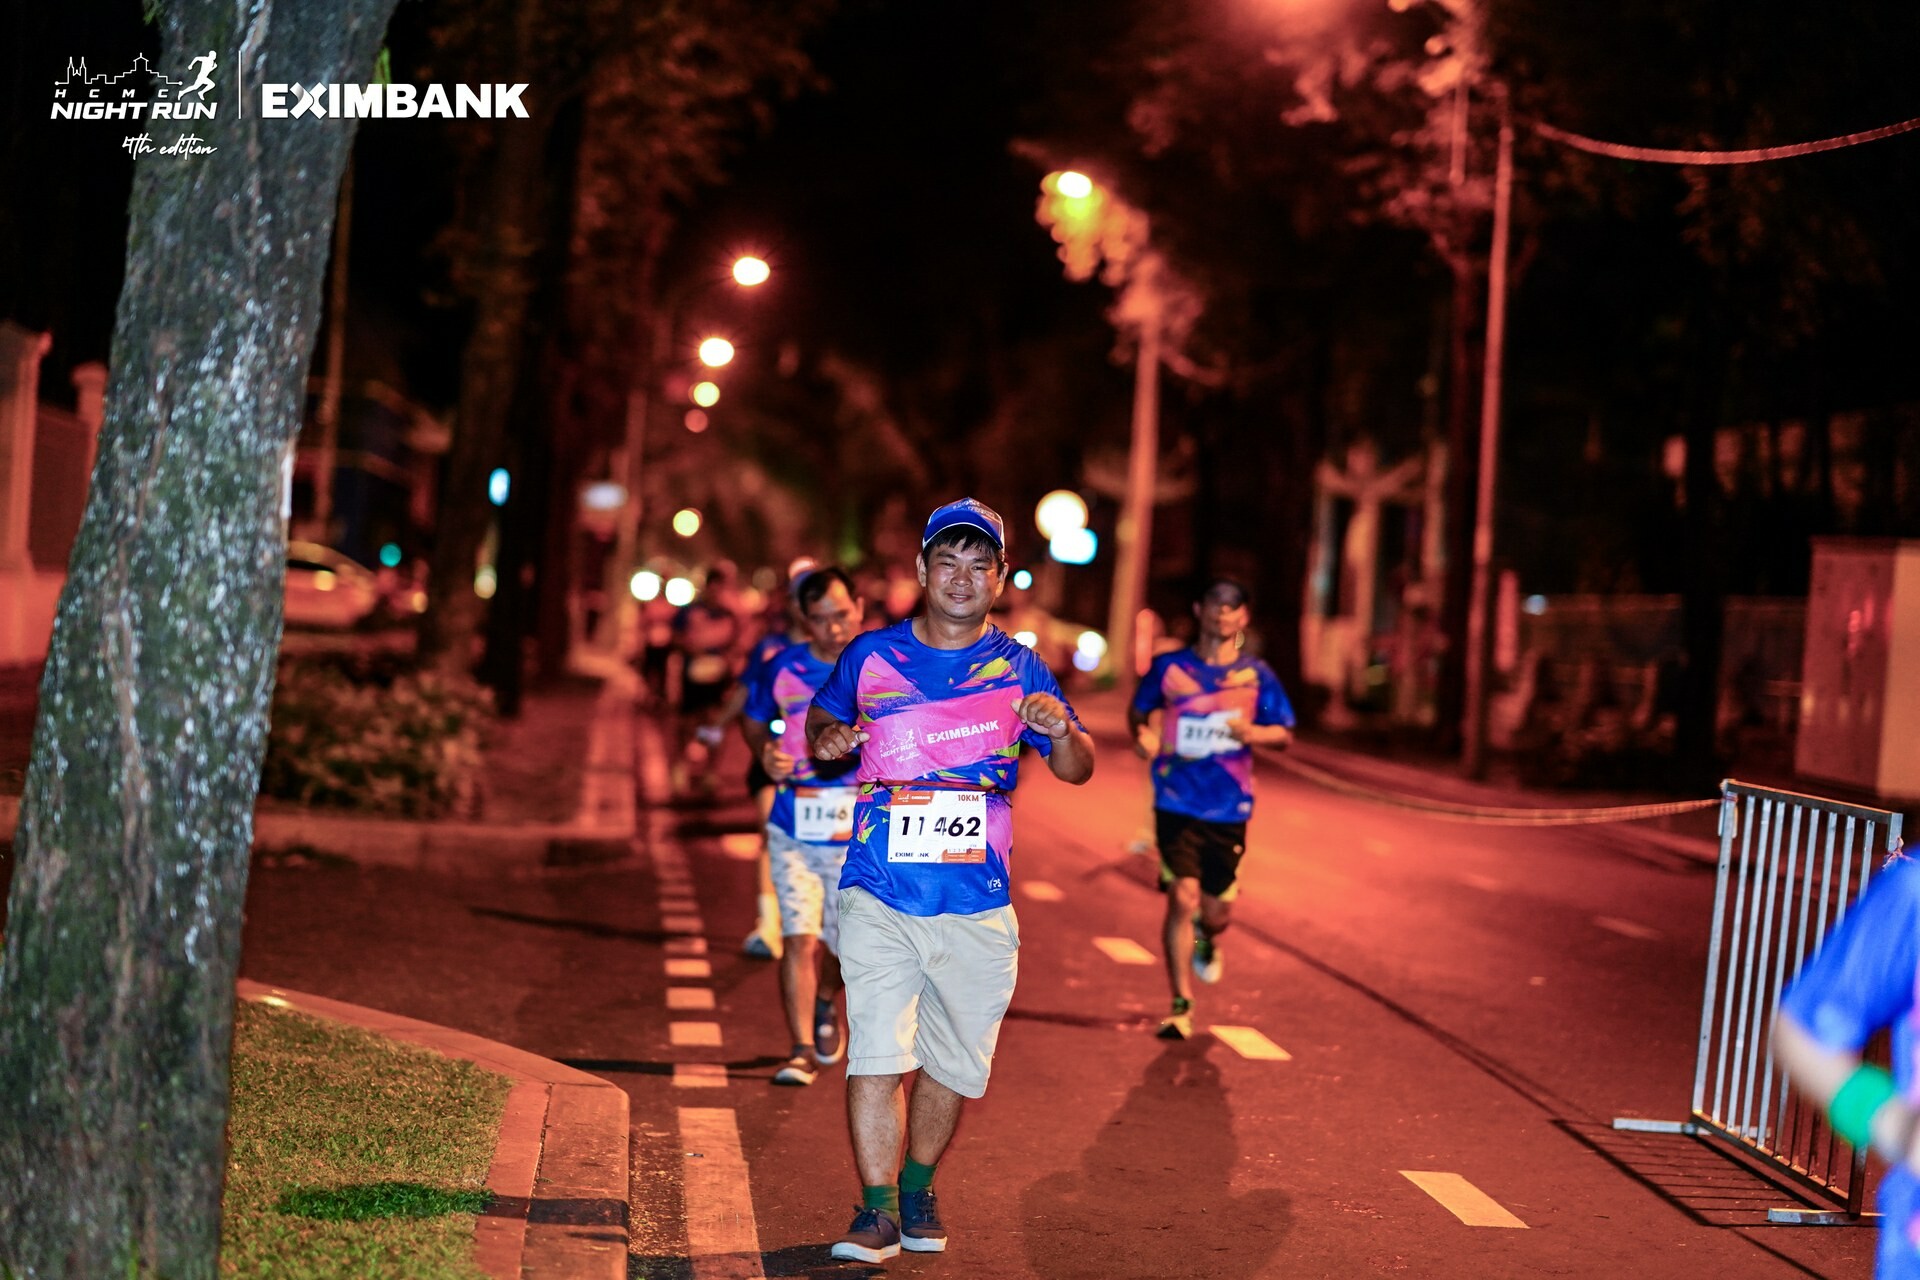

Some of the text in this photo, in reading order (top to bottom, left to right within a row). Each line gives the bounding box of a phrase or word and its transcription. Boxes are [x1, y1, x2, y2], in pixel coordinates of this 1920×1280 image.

[926, 719, 1000, 744] EXIMBANK
[957, 794, 979, 802] 10KM
[901, 816, 981, 837] 11462
